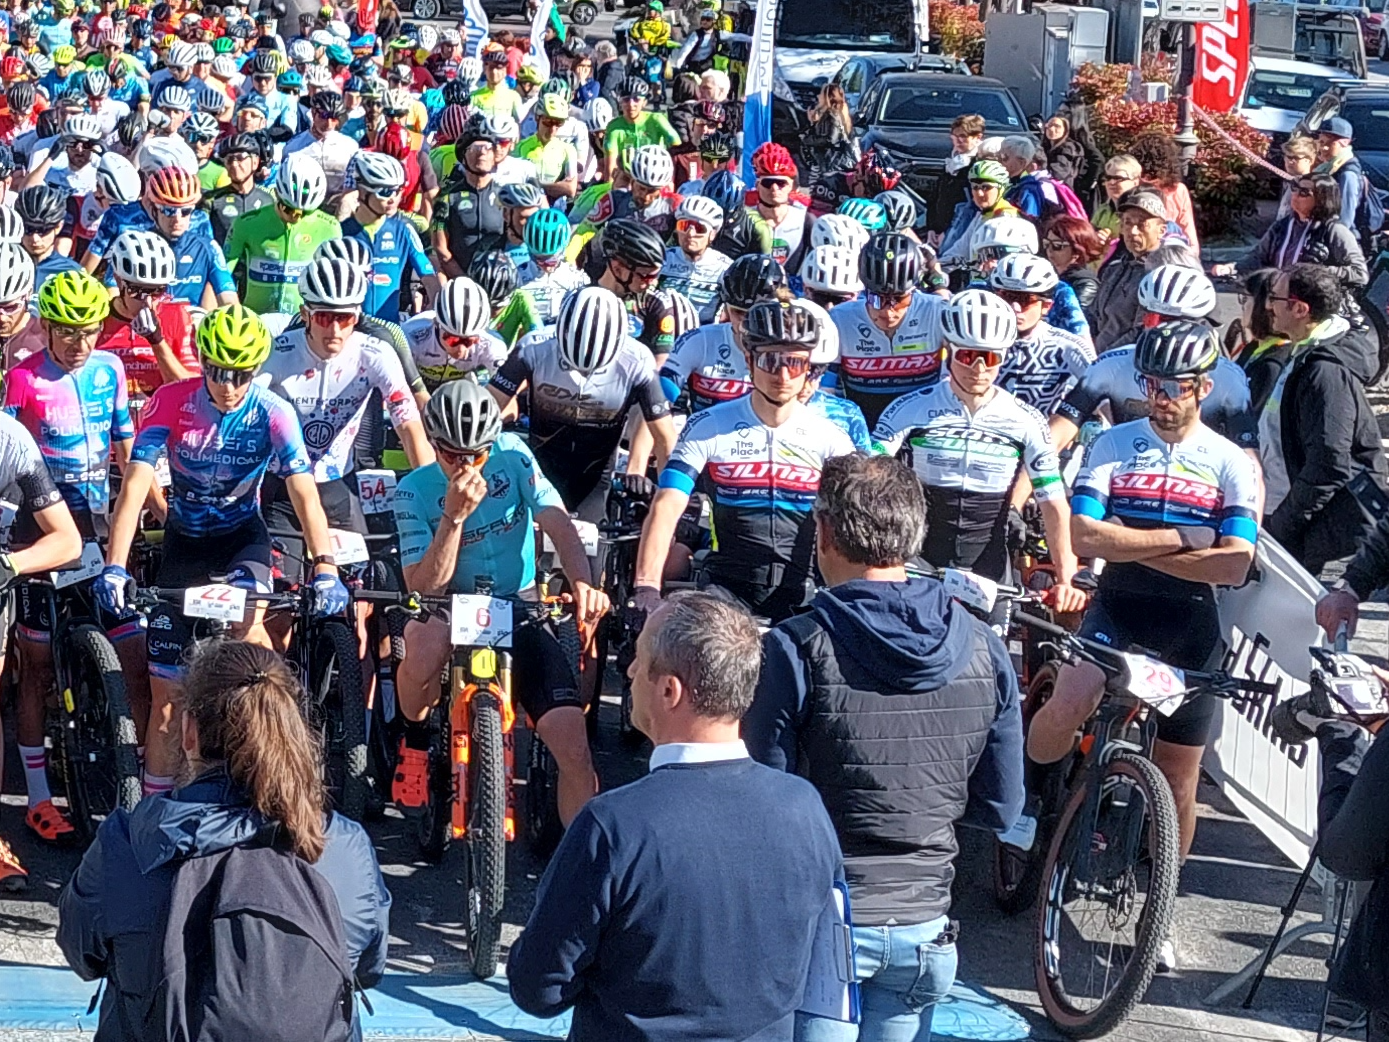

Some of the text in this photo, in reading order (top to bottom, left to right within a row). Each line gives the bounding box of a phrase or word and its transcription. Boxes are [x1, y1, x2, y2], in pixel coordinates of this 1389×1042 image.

[856, 344, 881, 353] Place
[845, 354, 936, 371] SILMAX
[730, 446, 760, 457] Place
[361, 478, 386, 500] 54
[475, 607, 492, 628] 6
[1142, 665, 1173, 693] 29
